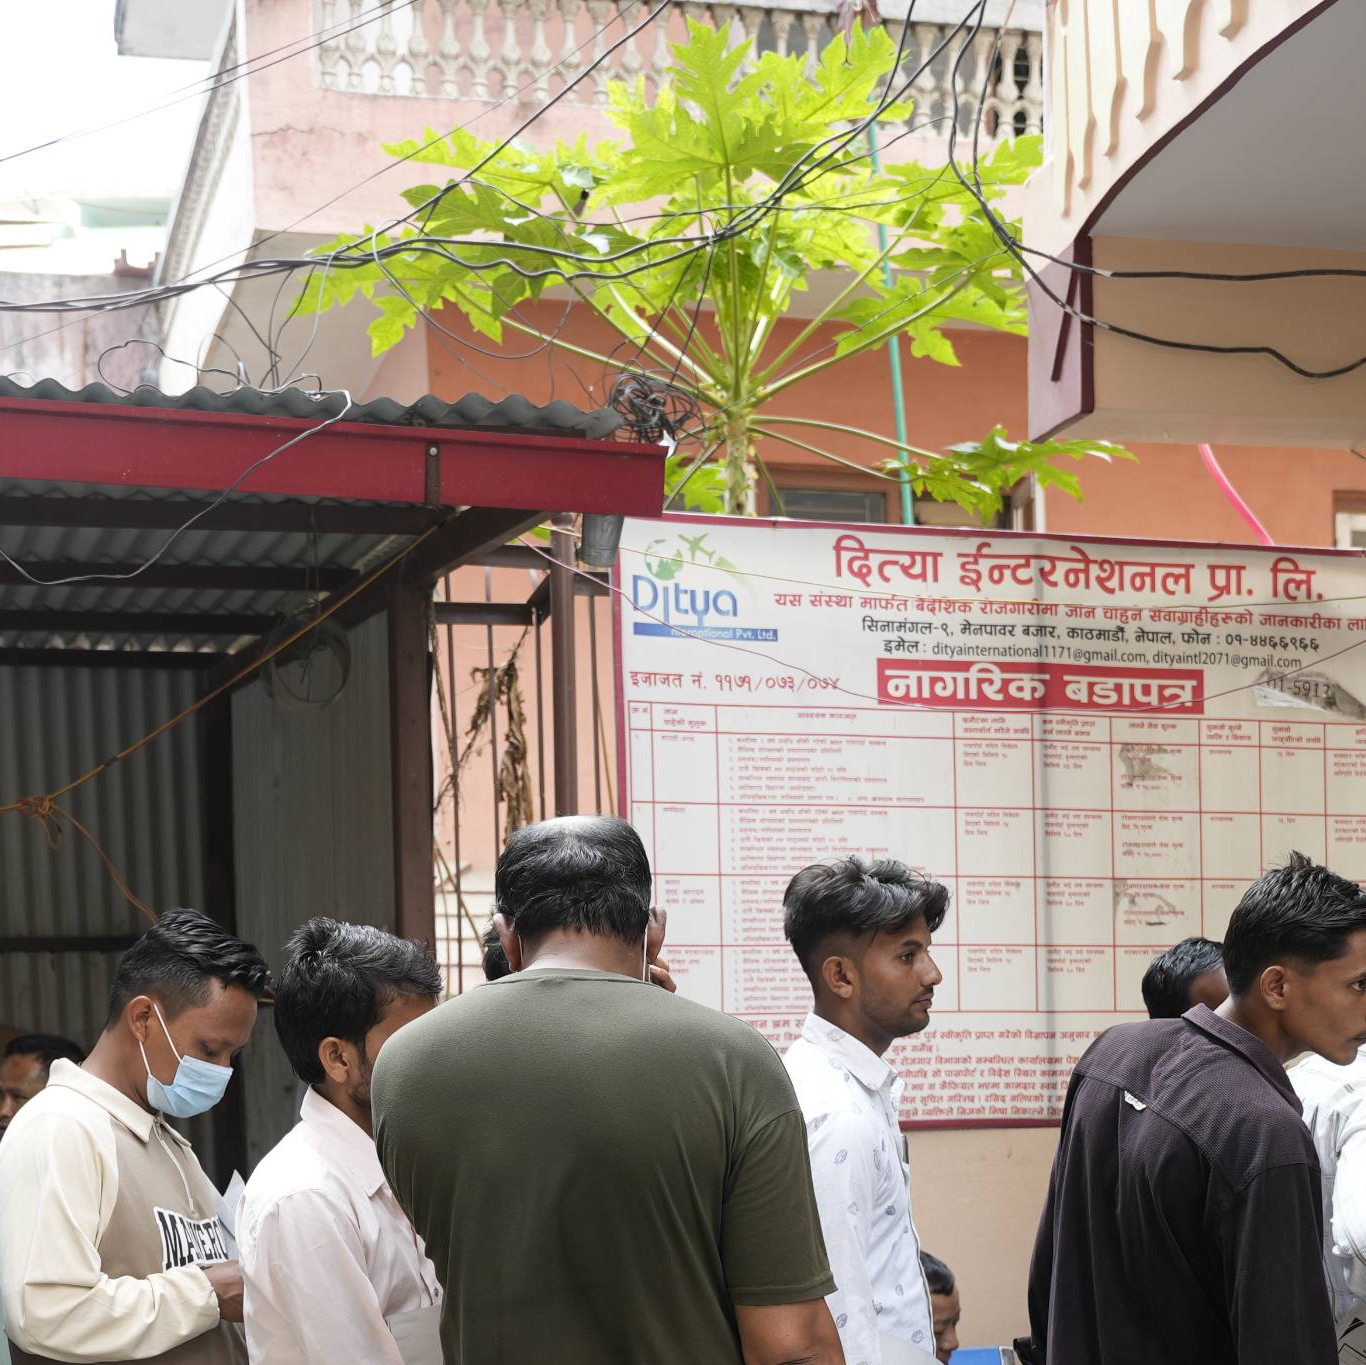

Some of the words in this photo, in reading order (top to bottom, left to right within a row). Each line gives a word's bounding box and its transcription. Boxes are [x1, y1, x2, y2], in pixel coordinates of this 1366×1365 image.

[833, 534, 943, 588] दित्या
[957, 542, 1195, 596] ईन्टरनेशनल
[1207, 564, 1253, 602] प्रा.
[1270, 557, 1323, 601] लि.
[775, 593, 803, 608] यस
[810, 591, 853, 609] संस्था
[860, 594, 908, 612] मार्फत
[1259, 612, 1341, 631] जानकारीका
[883, 636, 919, 654] इमेल
[629, 671, 684, 688] इजाजत
[885, 662, 1050, 701] नागरिक
[1063, 674, 1197, 708] बडापत्र
